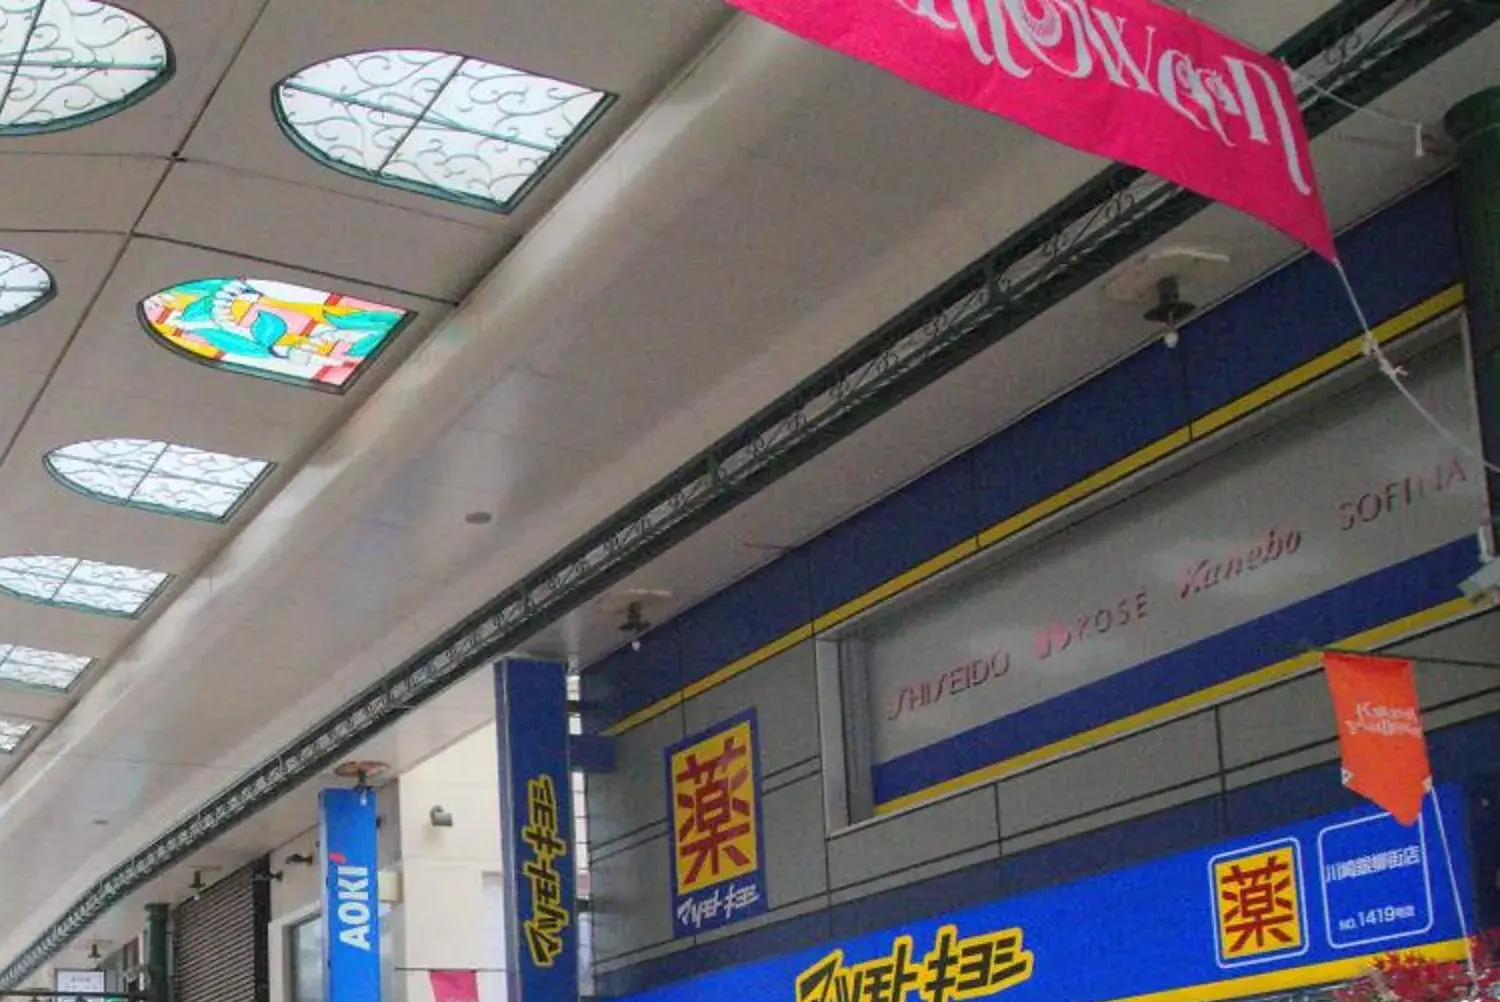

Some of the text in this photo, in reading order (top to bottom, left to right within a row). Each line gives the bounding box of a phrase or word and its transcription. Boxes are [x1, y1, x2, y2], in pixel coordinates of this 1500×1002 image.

[886, 650, 1011, 722] SHISEIDO
[1176, 526, 1303, 600] Kanebo
[522, 774, 569, 968] マツモトキヨシ
[677, 735, 750, 884] 薬
[338, 865, 371, 951] AOKI
[677, 884, 760, 928] マツモトキヨシ
[1221, 855, 1294, 952] 薬
